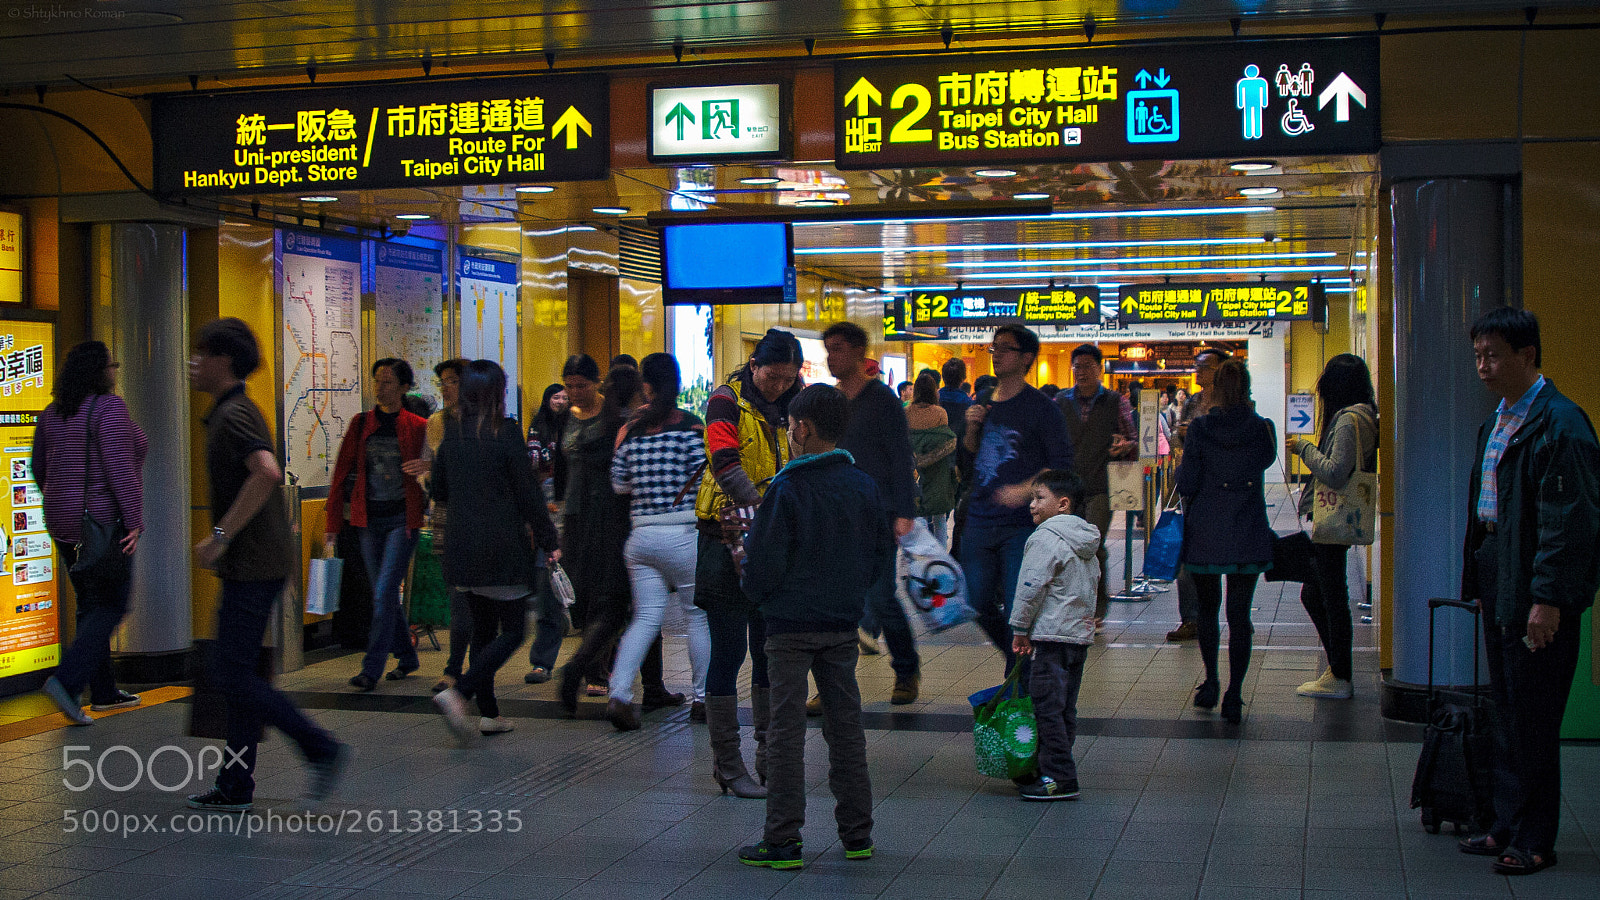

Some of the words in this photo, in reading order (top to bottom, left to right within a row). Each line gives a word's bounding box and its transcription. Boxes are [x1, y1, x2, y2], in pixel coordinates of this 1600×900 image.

[938, 66, 1117, 107] 市府轉運站
[387, 97, 544, 137] 市府連通道
[890, 84, 932, 142] 2
[939, 109, 1003, 131] Taipei
[1009, 106, 1052, 129] City
[1057, 105, 1097, 124] Hall
[236, 108, 357, 146] 統一阪急
[846, 117, 882, 153] 出口
[449, 136, 506, 155] Route
[512, 134, 545, 152] For
[864, 142, 882, 152] EXIT
[939, 132, 979, 150] Bus
[984, 128, 1059, 149] Station
[234, 144, 358, 168] Uni-president
[401, 158, 459, 180] Taipei
[463, 156, 503, 177] City
[508, 152, 545, 172] Hall
[184, 168, 250, 189] Hankyu
[255, 166, 303, 187] Dept.
[308, 164, 358, 182] Store
[932, 295, 949, 318] 2
[1025, 304, 1077, 314] Uni-president
[1139, 302, 1162, 311] Route
[1163, 302, 1178, 311] For
[1217, 301, 1241, 311] Taipei
[1242, 301, 1259, 311] City
[1259, 300, 1275, 309] Hall
[1223, 309, 1239, 318] Bus
[1240, 308, 1268, 318] Station
[1277, 291, 1293, 313] 2
[1026, 312, 1055, 321] Hankyu
[1056, 311, 1077, 321] Dept.
[1140, 310, 1164, 320] Taipei
[1164, 310, 1180, 320] City
[1181, 309, 1197, 318] Hall
[1317, 491, 1337, 507] 30
